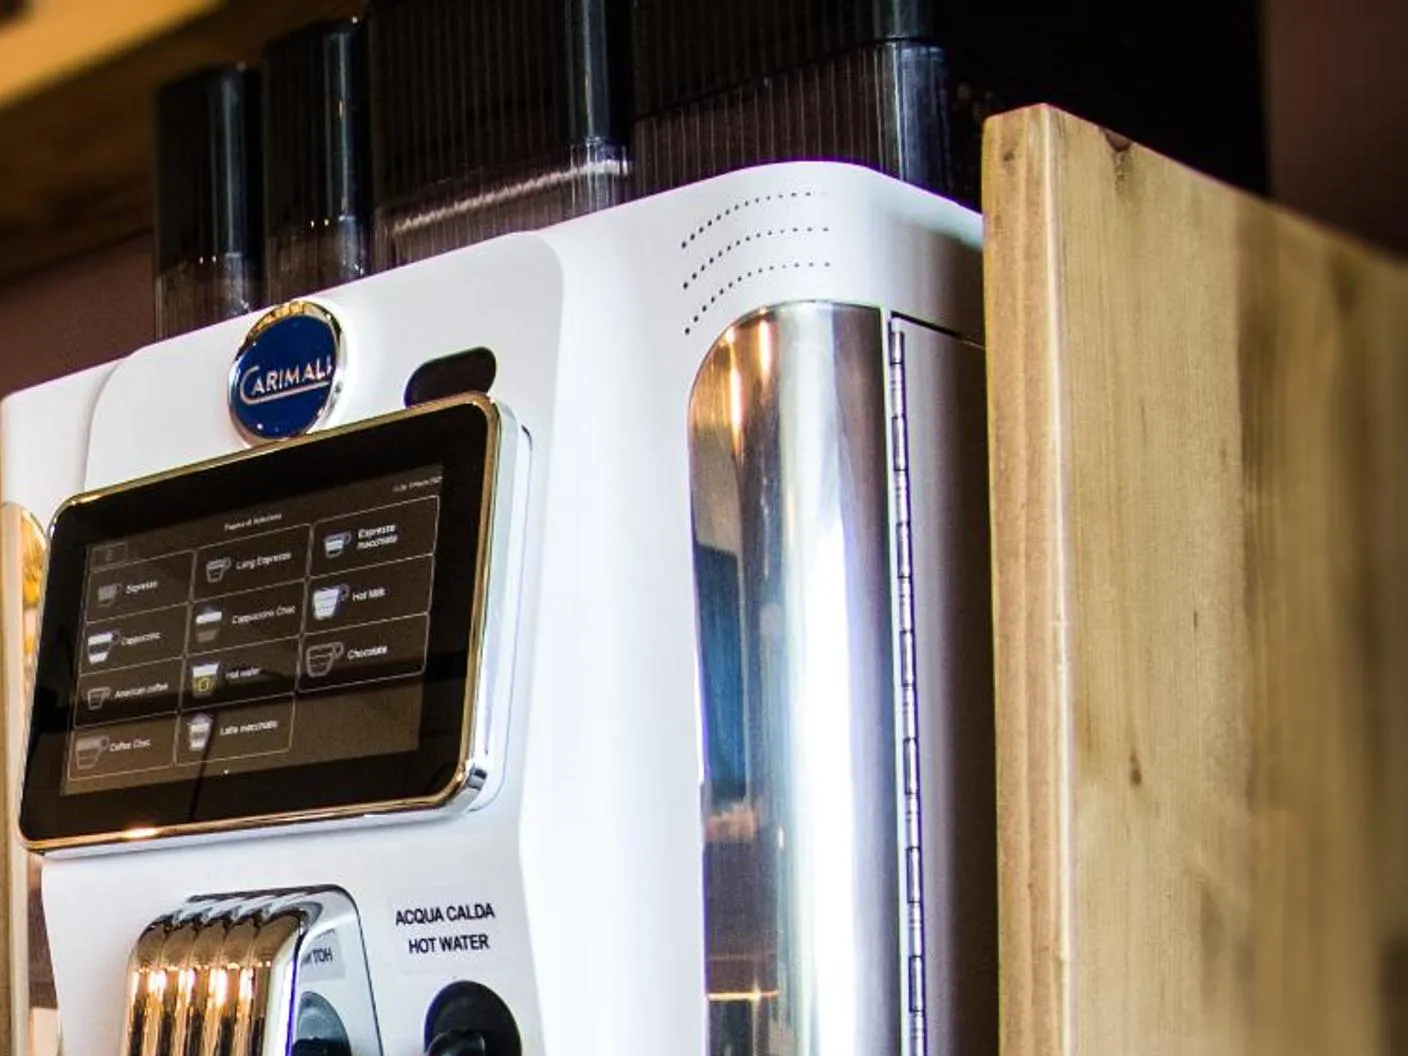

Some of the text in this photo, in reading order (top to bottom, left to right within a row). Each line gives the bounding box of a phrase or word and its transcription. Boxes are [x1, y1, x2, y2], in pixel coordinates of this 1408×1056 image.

[241, 355, 332, 405] CARIMALI
[395, 902, 495, 926] ACQUA CALDA
[408, 933, 490, 954] HOT WATER
